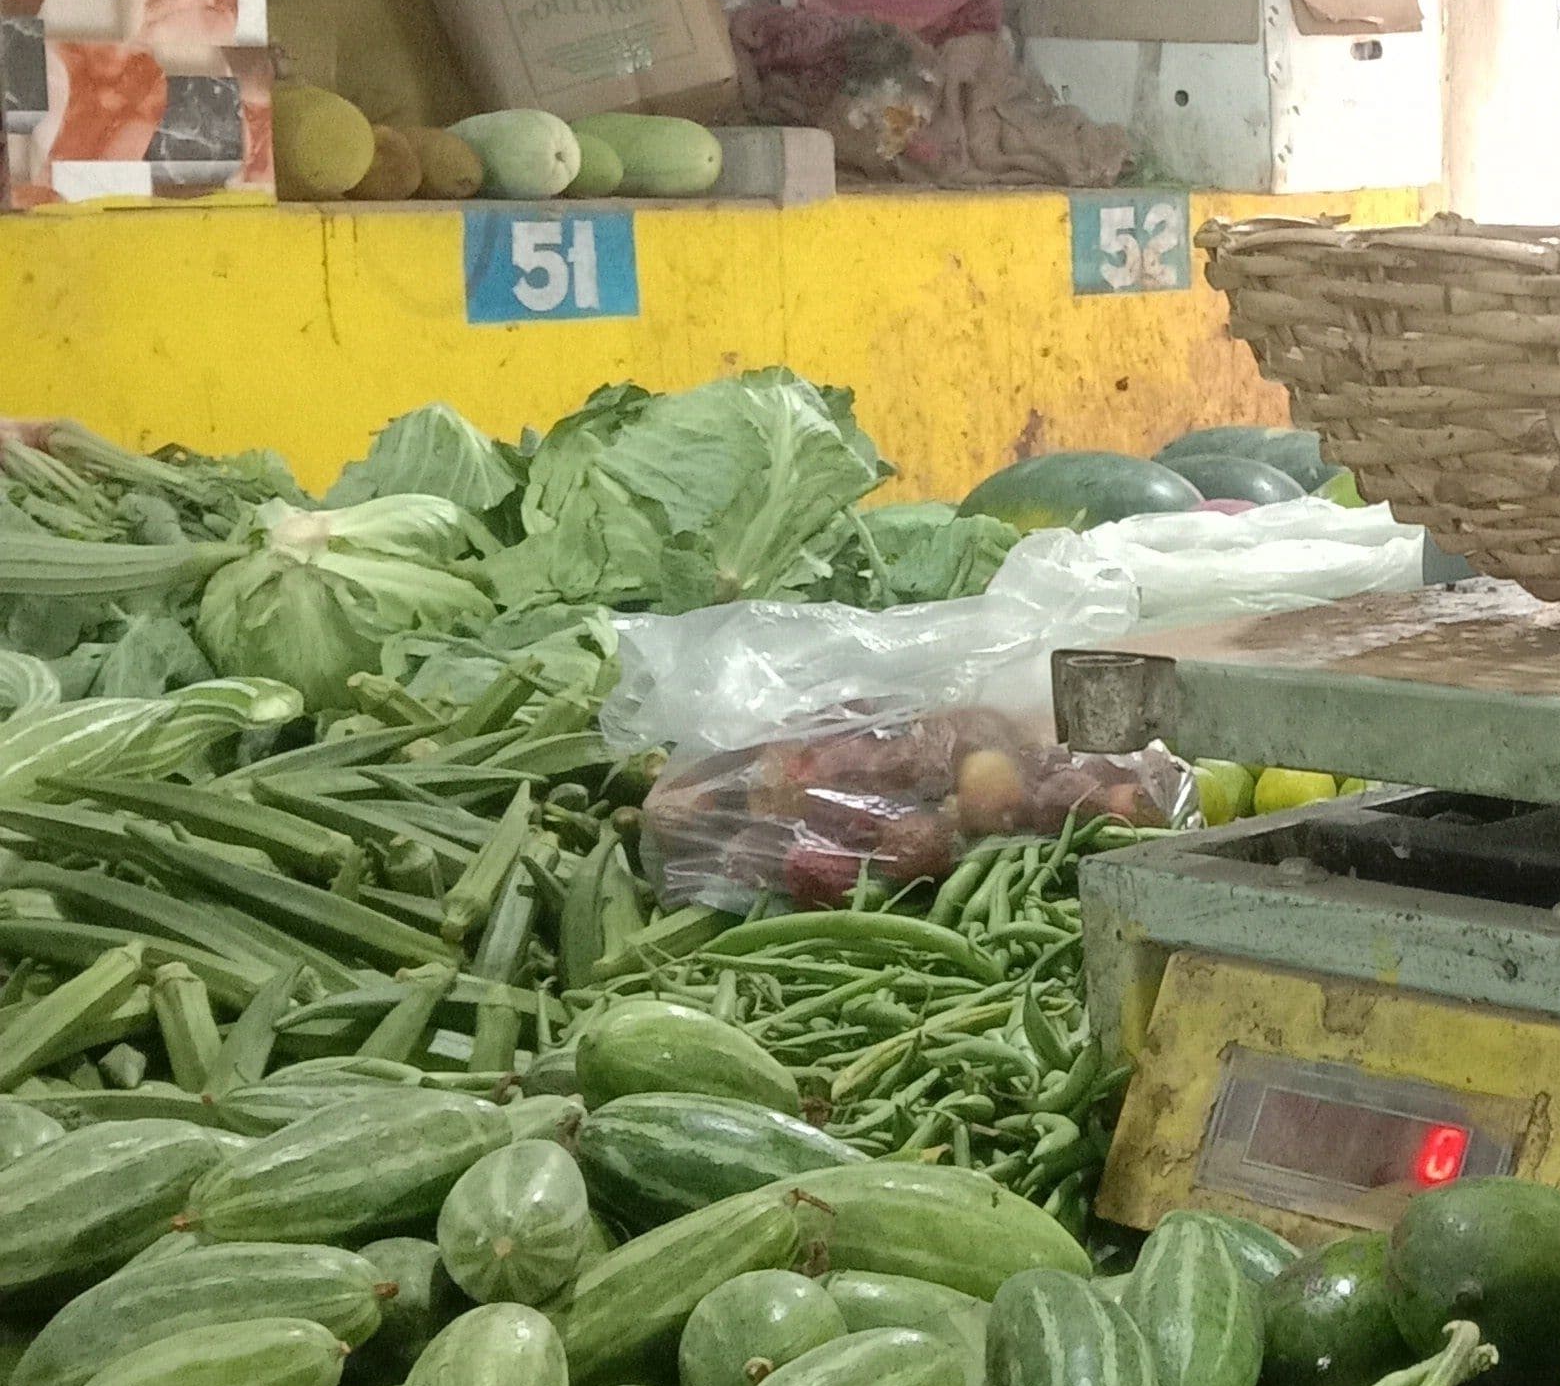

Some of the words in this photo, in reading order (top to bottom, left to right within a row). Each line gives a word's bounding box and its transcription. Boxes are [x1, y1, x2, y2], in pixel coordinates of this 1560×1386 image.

[512, 220, 599, 312] 51
[1100, 203, 1178, 290] 52
[1423, 1125, 1465, 1183] 0
